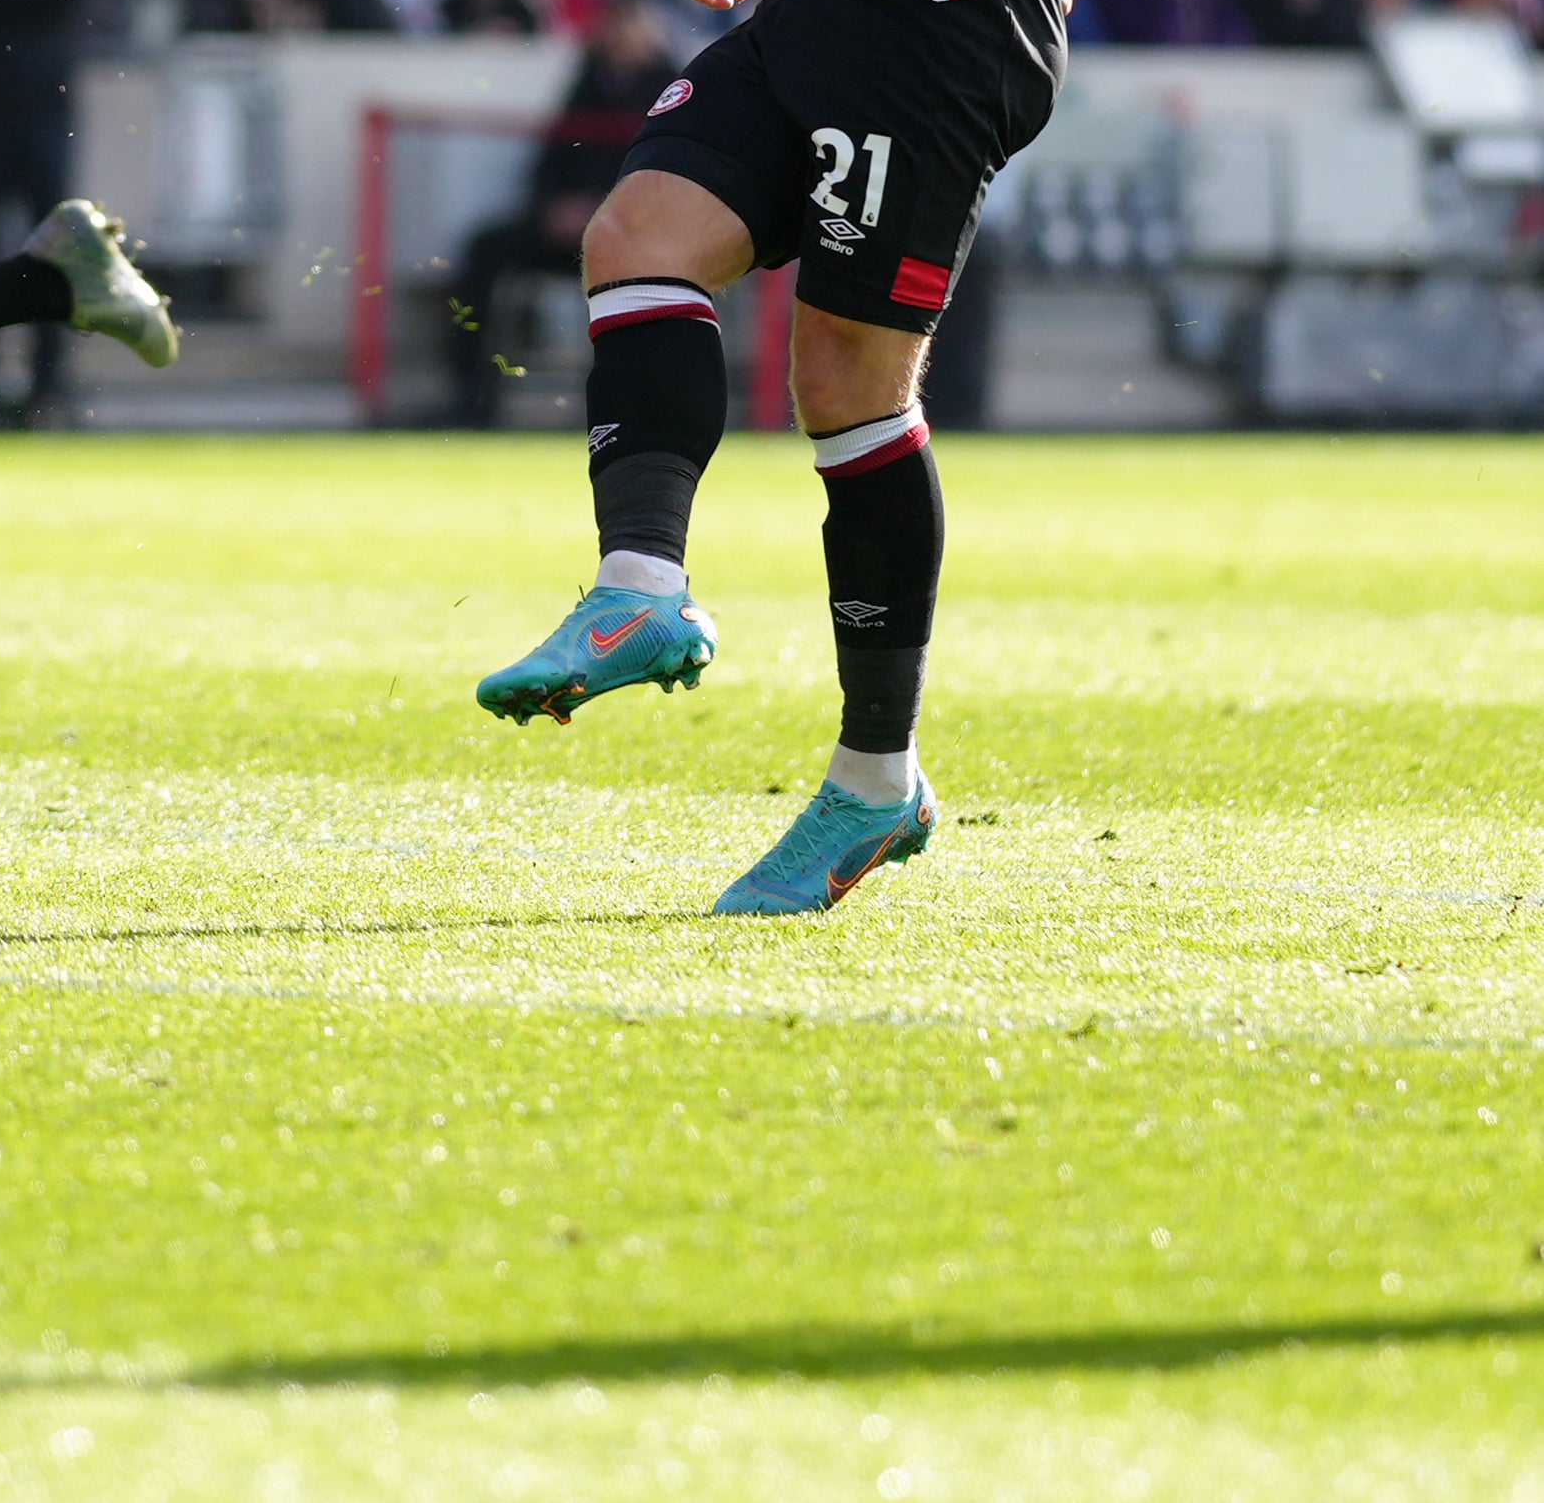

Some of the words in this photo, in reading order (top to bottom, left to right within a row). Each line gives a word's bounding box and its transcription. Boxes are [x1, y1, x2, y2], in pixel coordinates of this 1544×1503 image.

[809, 127, 892, 228] 21
[819, 235, 855, 257] umbro
[835, 615, 886, 629] umbro
